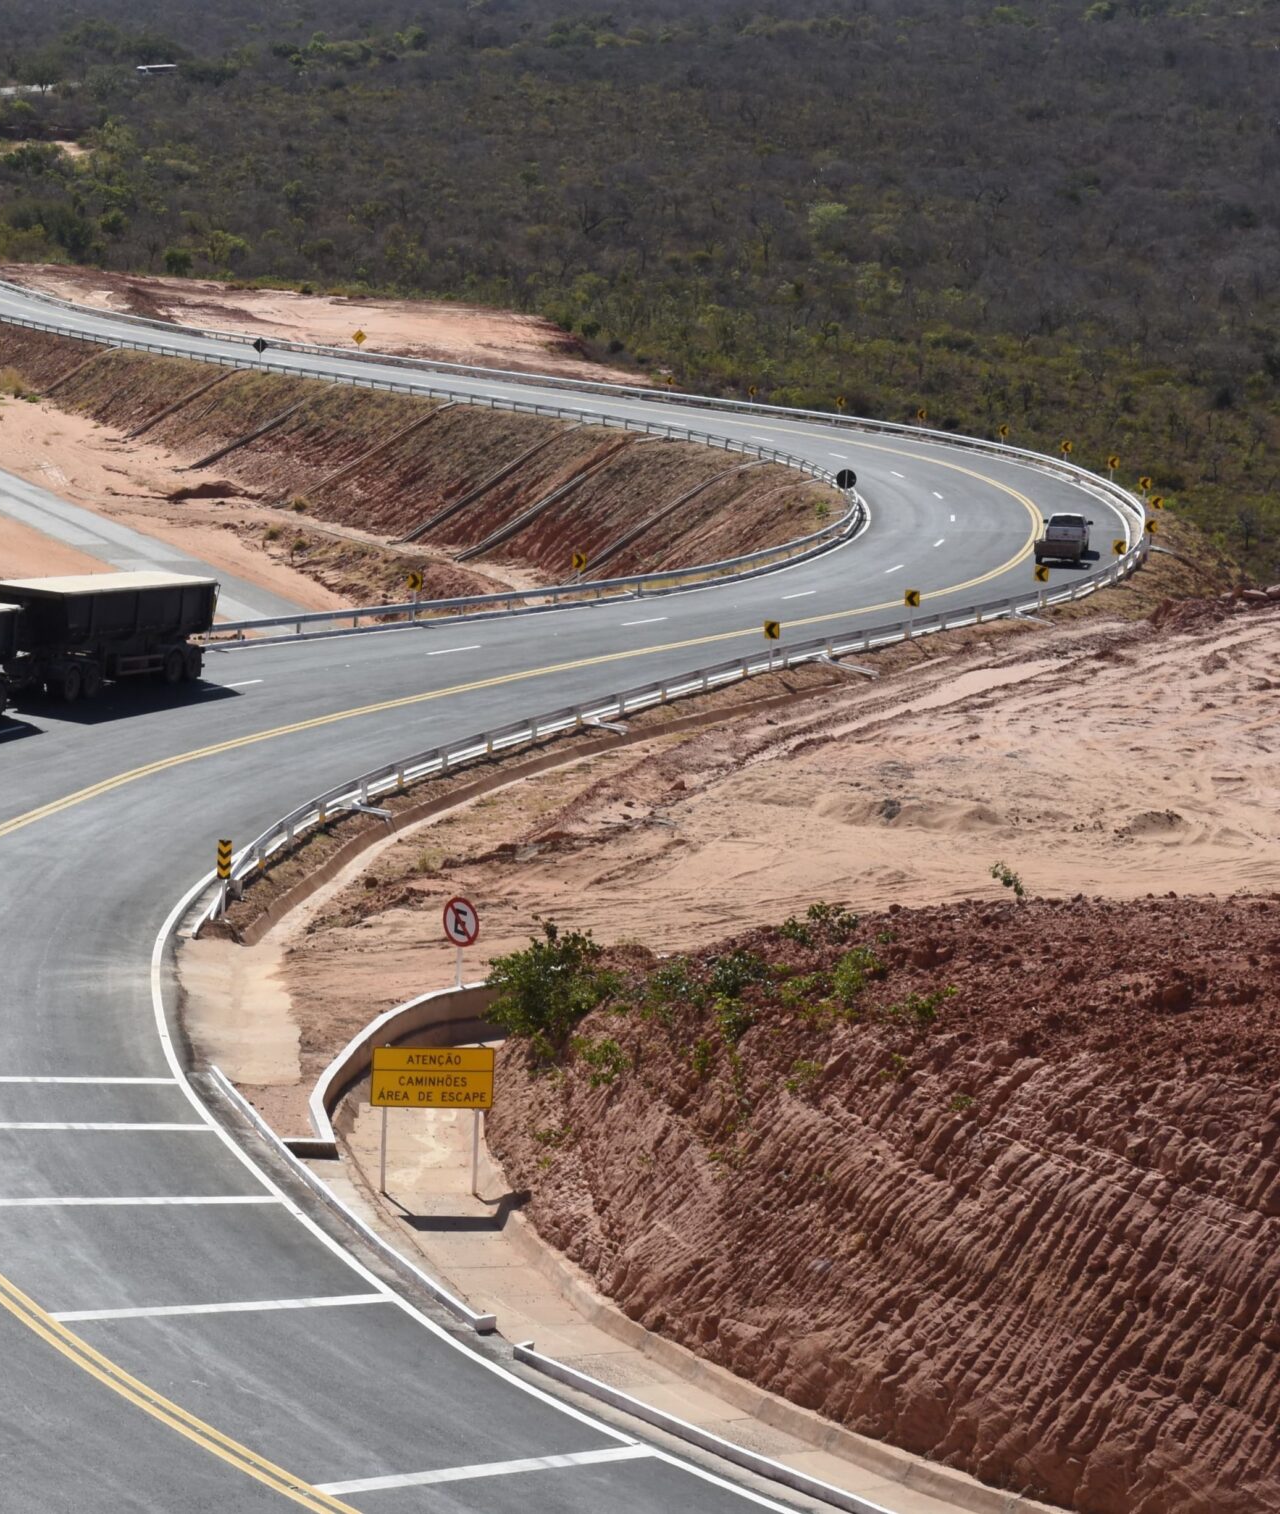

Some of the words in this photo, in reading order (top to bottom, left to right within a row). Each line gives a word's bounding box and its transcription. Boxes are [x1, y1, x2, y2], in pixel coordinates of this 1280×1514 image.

[407, 1053, 462, 1066] ATENÇÃO
[398, 1075, 468, 1087] CAMINHÕES
[378, 1088, 410, 1101] ÁREA
[418, 1091, 433, 1102] DE
[441, 1092, 487, 1102] ESCAPE
